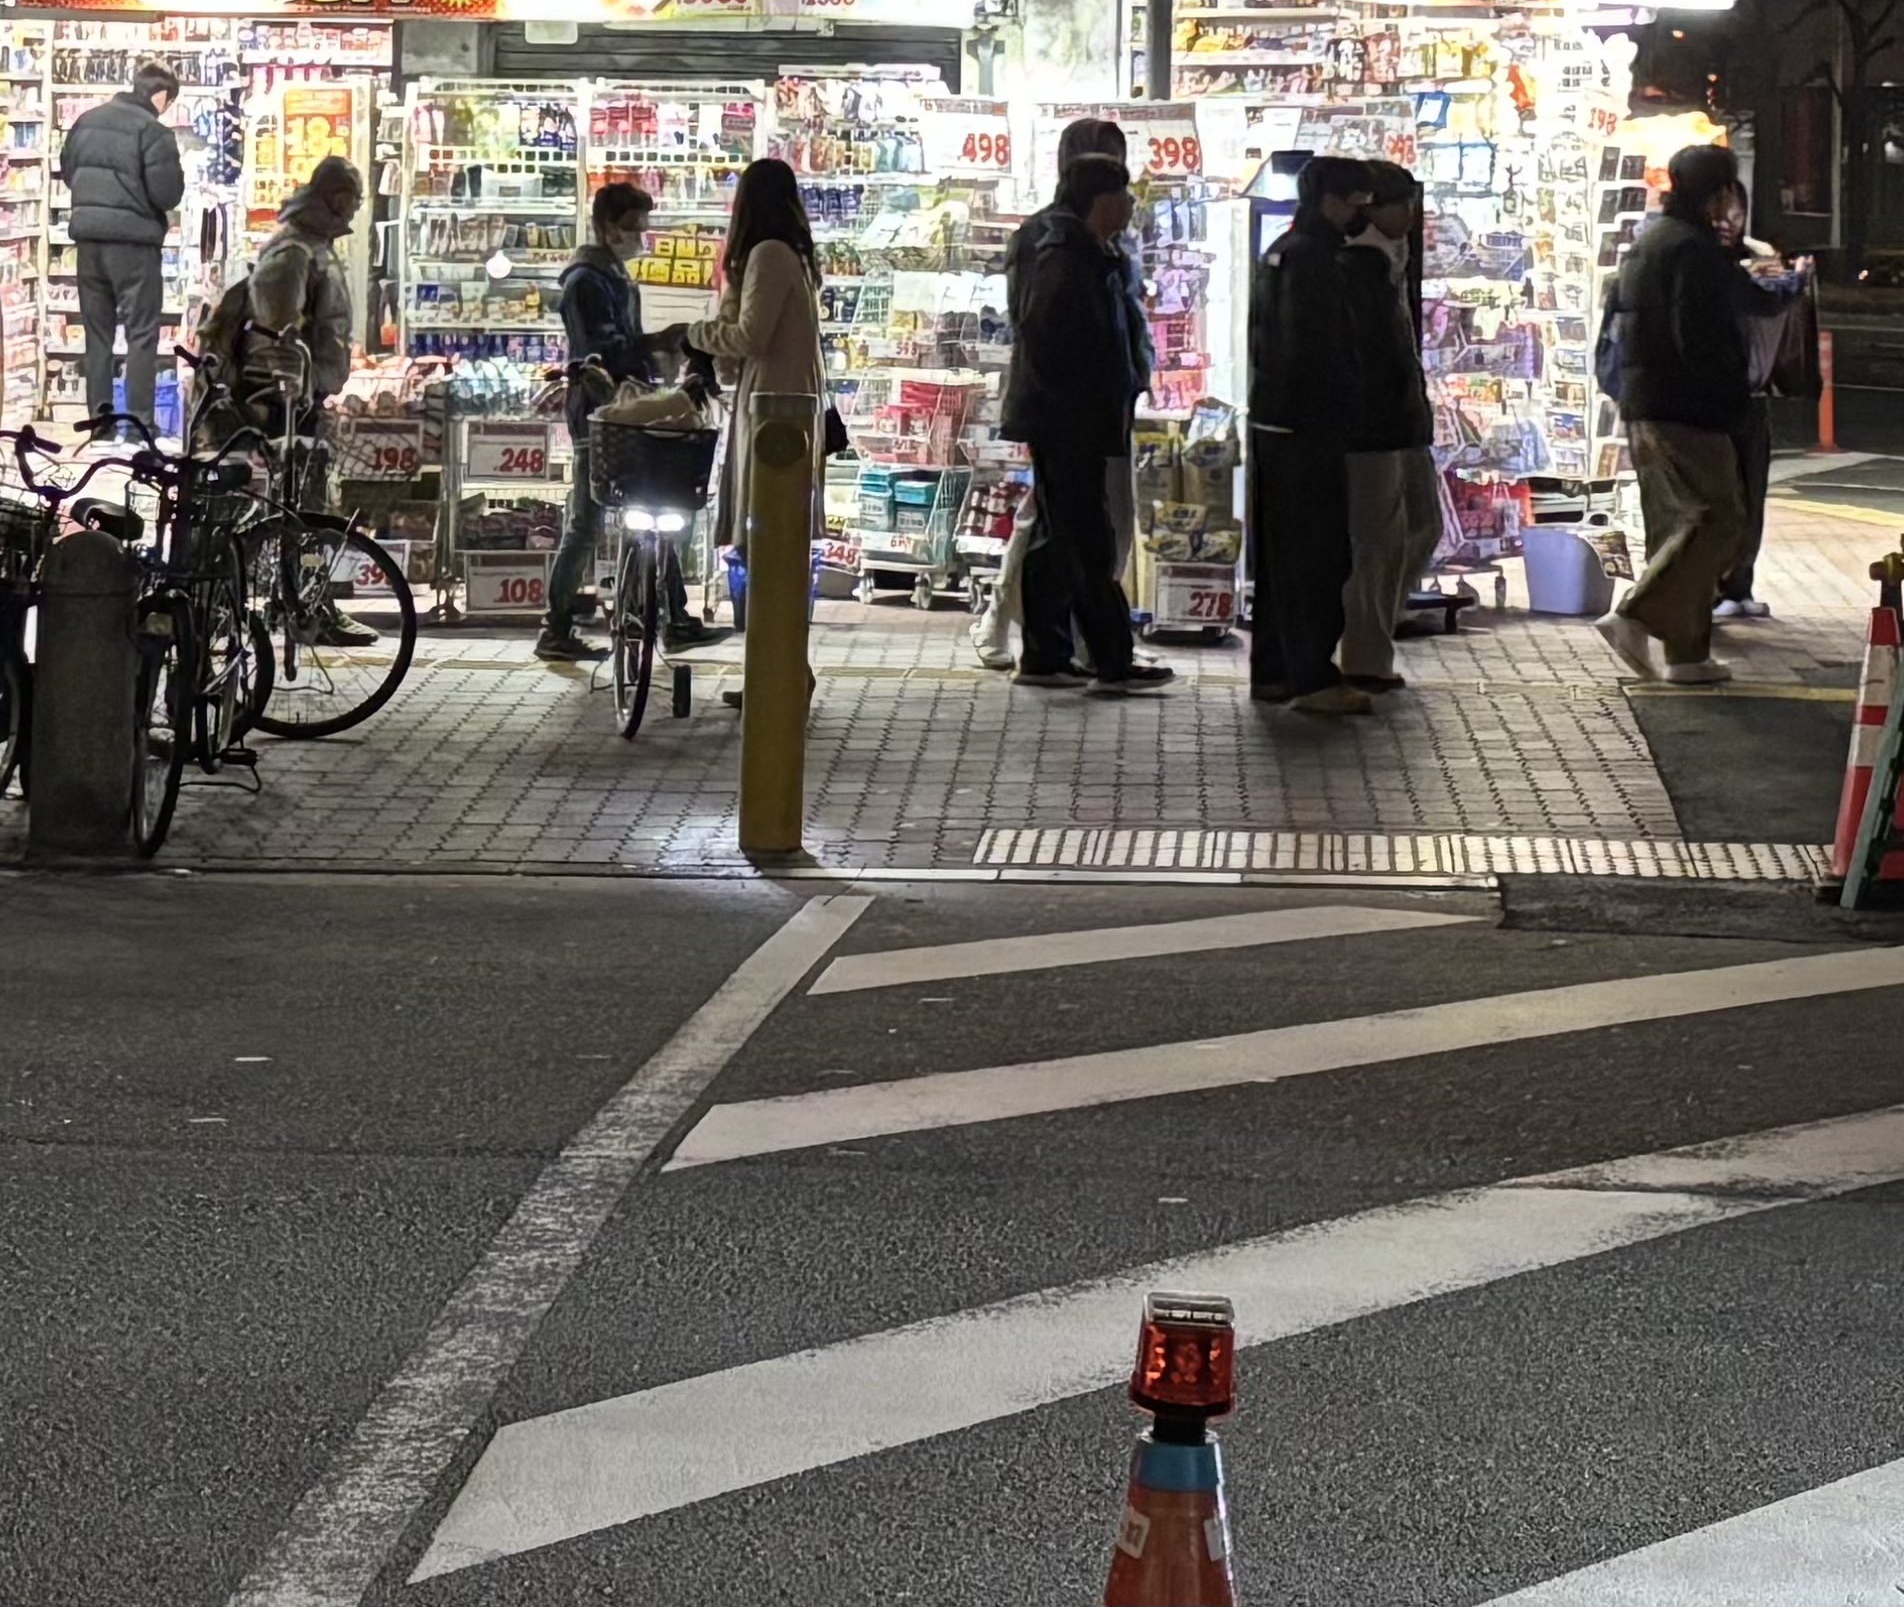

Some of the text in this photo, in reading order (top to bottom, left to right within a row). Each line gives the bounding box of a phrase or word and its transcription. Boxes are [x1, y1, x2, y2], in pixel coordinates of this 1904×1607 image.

[962, 133, 1009, 167] 498
[1148, 137, 1198, 173] 398
[499, 448, 544, 471] 248
[356, 564, 390, 586] 39
